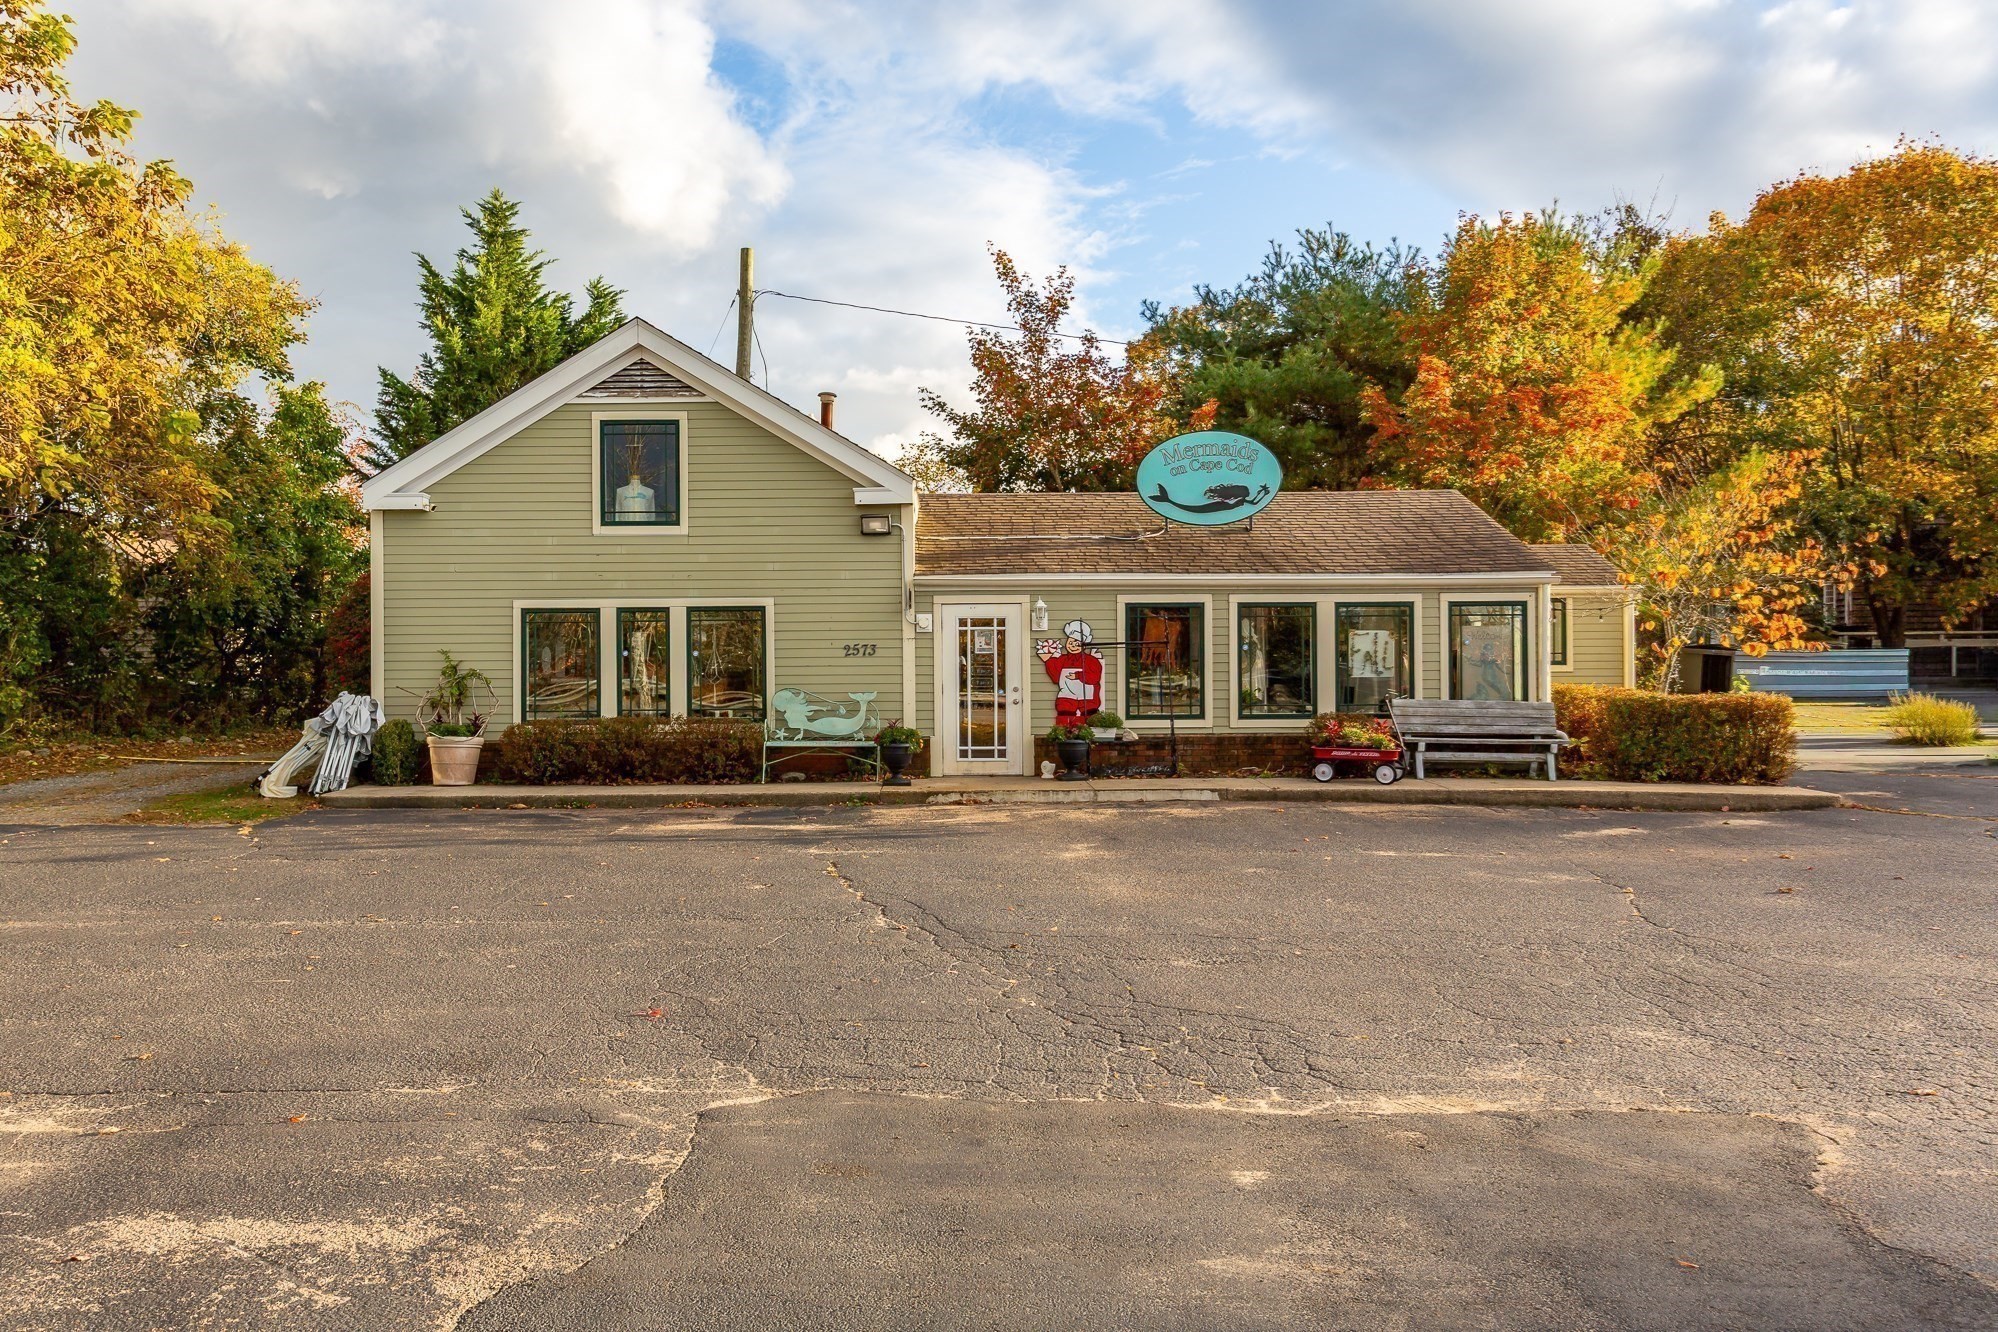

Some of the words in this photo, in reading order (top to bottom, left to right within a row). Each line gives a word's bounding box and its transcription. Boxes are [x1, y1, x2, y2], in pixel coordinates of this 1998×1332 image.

[1160, 439, 1259, 466] Mermaids
[1170, 464, 1187, 476] on
[1189, 459, 1222, 473] Cape
[1226, 459, 1254, 474] Cod
[843, 643, 877, 657] 2573
